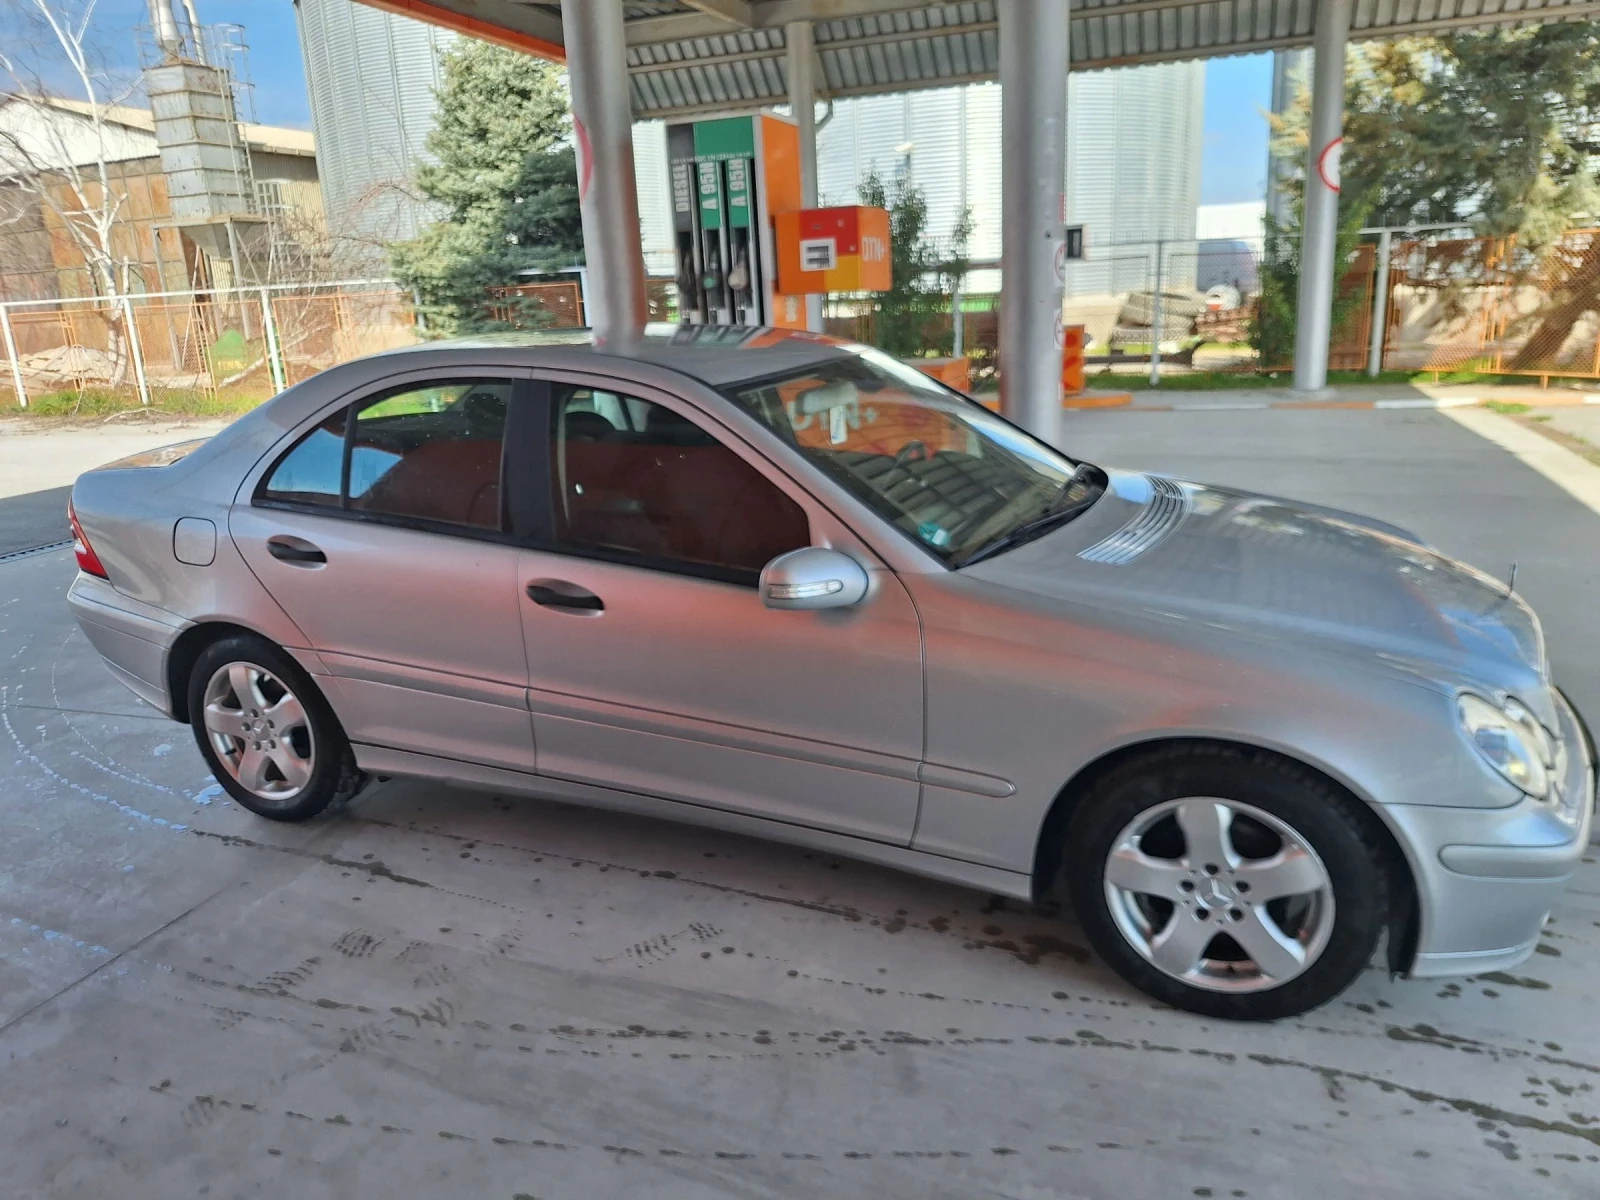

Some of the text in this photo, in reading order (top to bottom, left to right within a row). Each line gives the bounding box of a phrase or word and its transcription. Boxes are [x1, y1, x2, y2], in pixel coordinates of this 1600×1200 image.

[673, 163, 690, 212] DIESEL
[702, 198, 717, 210] A
[730, 195, 746, 207] A
